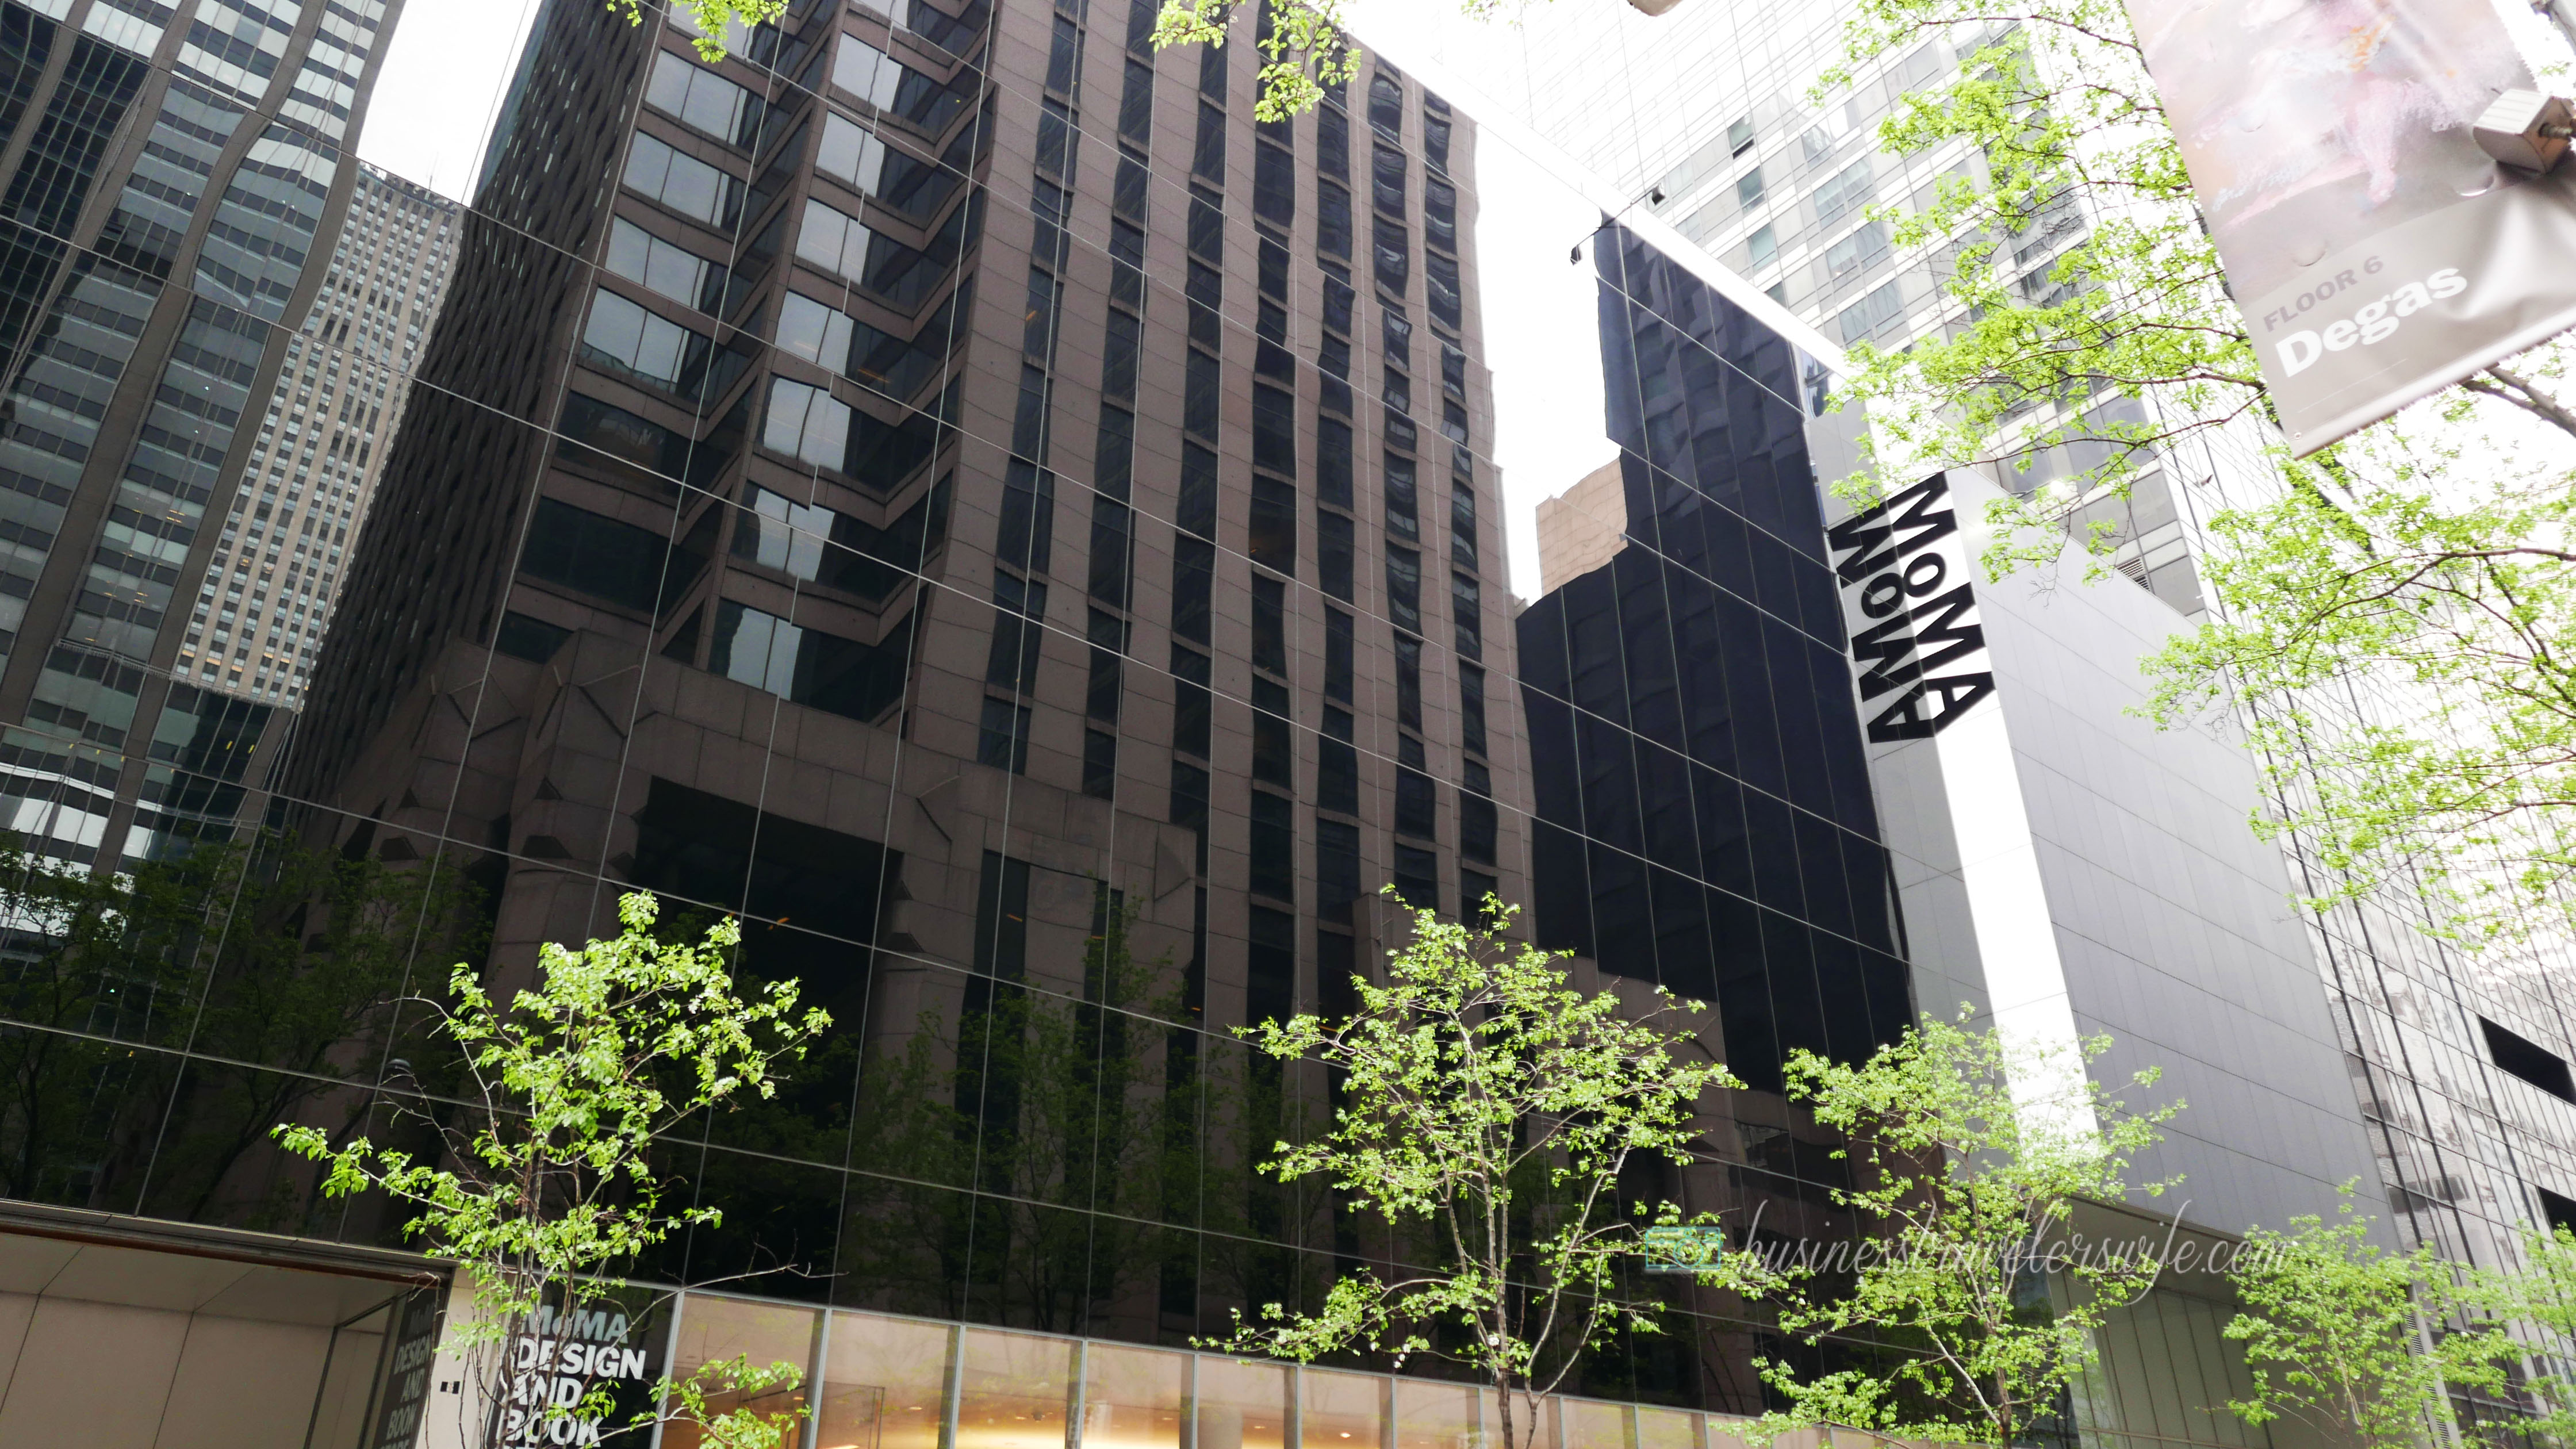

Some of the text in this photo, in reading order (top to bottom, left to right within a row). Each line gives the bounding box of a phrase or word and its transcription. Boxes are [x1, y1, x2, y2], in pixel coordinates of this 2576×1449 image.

[2263, 256, 2383, 332] FLOOR 6
[2275, 269, 2467, 378] Degas
[1887, 471, 1996, 736] MoMA
[522, 1302, 628, 1344] MoMA
[518, 1336, 646, 1381] DESIGN
[400, 1368, 425, 1404] AND
[496, 1409, 604, 1447] BOOK
